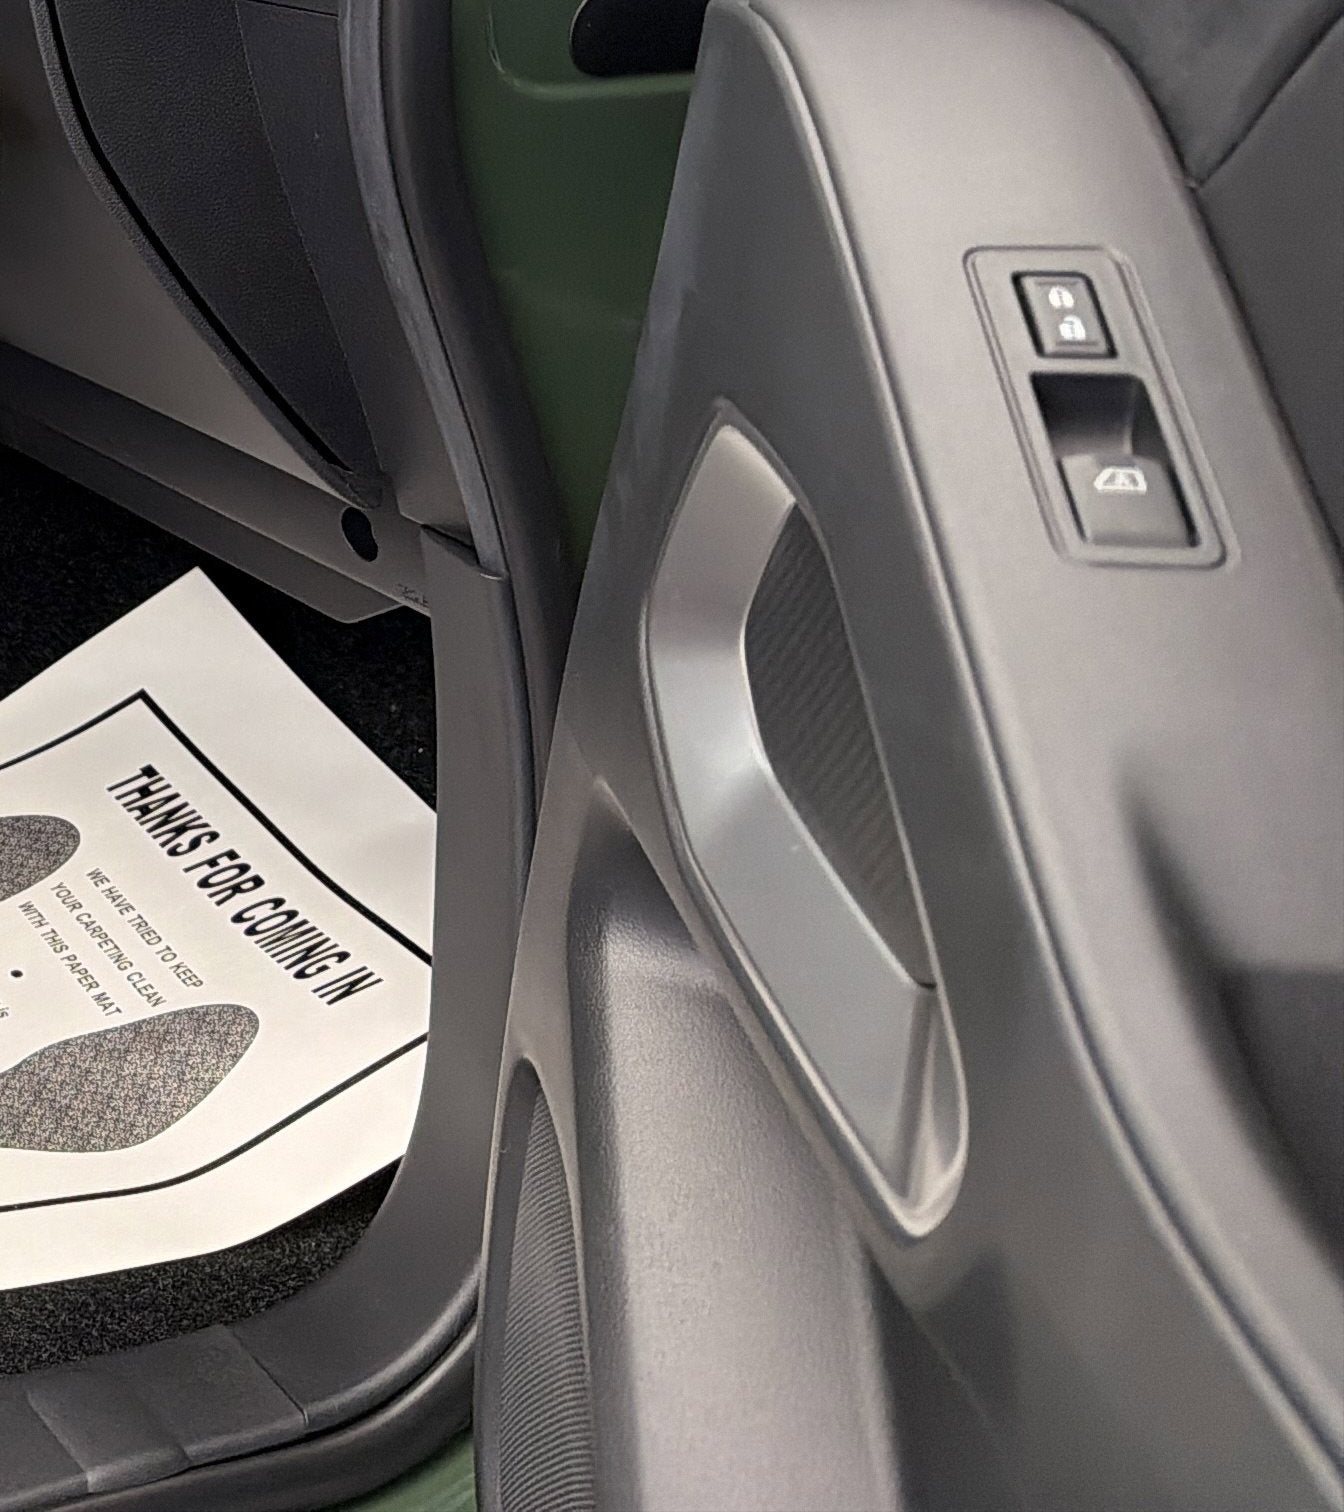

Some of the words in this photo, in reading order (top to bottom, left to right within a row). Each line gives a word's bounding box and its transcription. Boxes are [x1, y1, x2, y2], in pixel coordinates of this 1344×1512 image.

[50, 881, 83, 913] YOUR
[75, 912, 134, 972] CARPETING
[126, 971, 167, 1008] CLEAN
[86, 867, 111, 888] WE
[101, 886, 136, 916] HAVE
[127, 913, 163, 946] TRIED
[155, 944, 178, 963] TO
[169, 961, 204, 988] KEEP
[107, 764, 221, 857] THANKS
[182, 849, 266, 907] FOR
[230, 897, 352, 980] COMING
[311, 966, 384, 1006] IN
[18, 900, 50, 929] WITH
[41, 928, 69, 954] THIS
[60, 953, 100, 992] PAPER
[91, 991, 122, 1017] MAT
